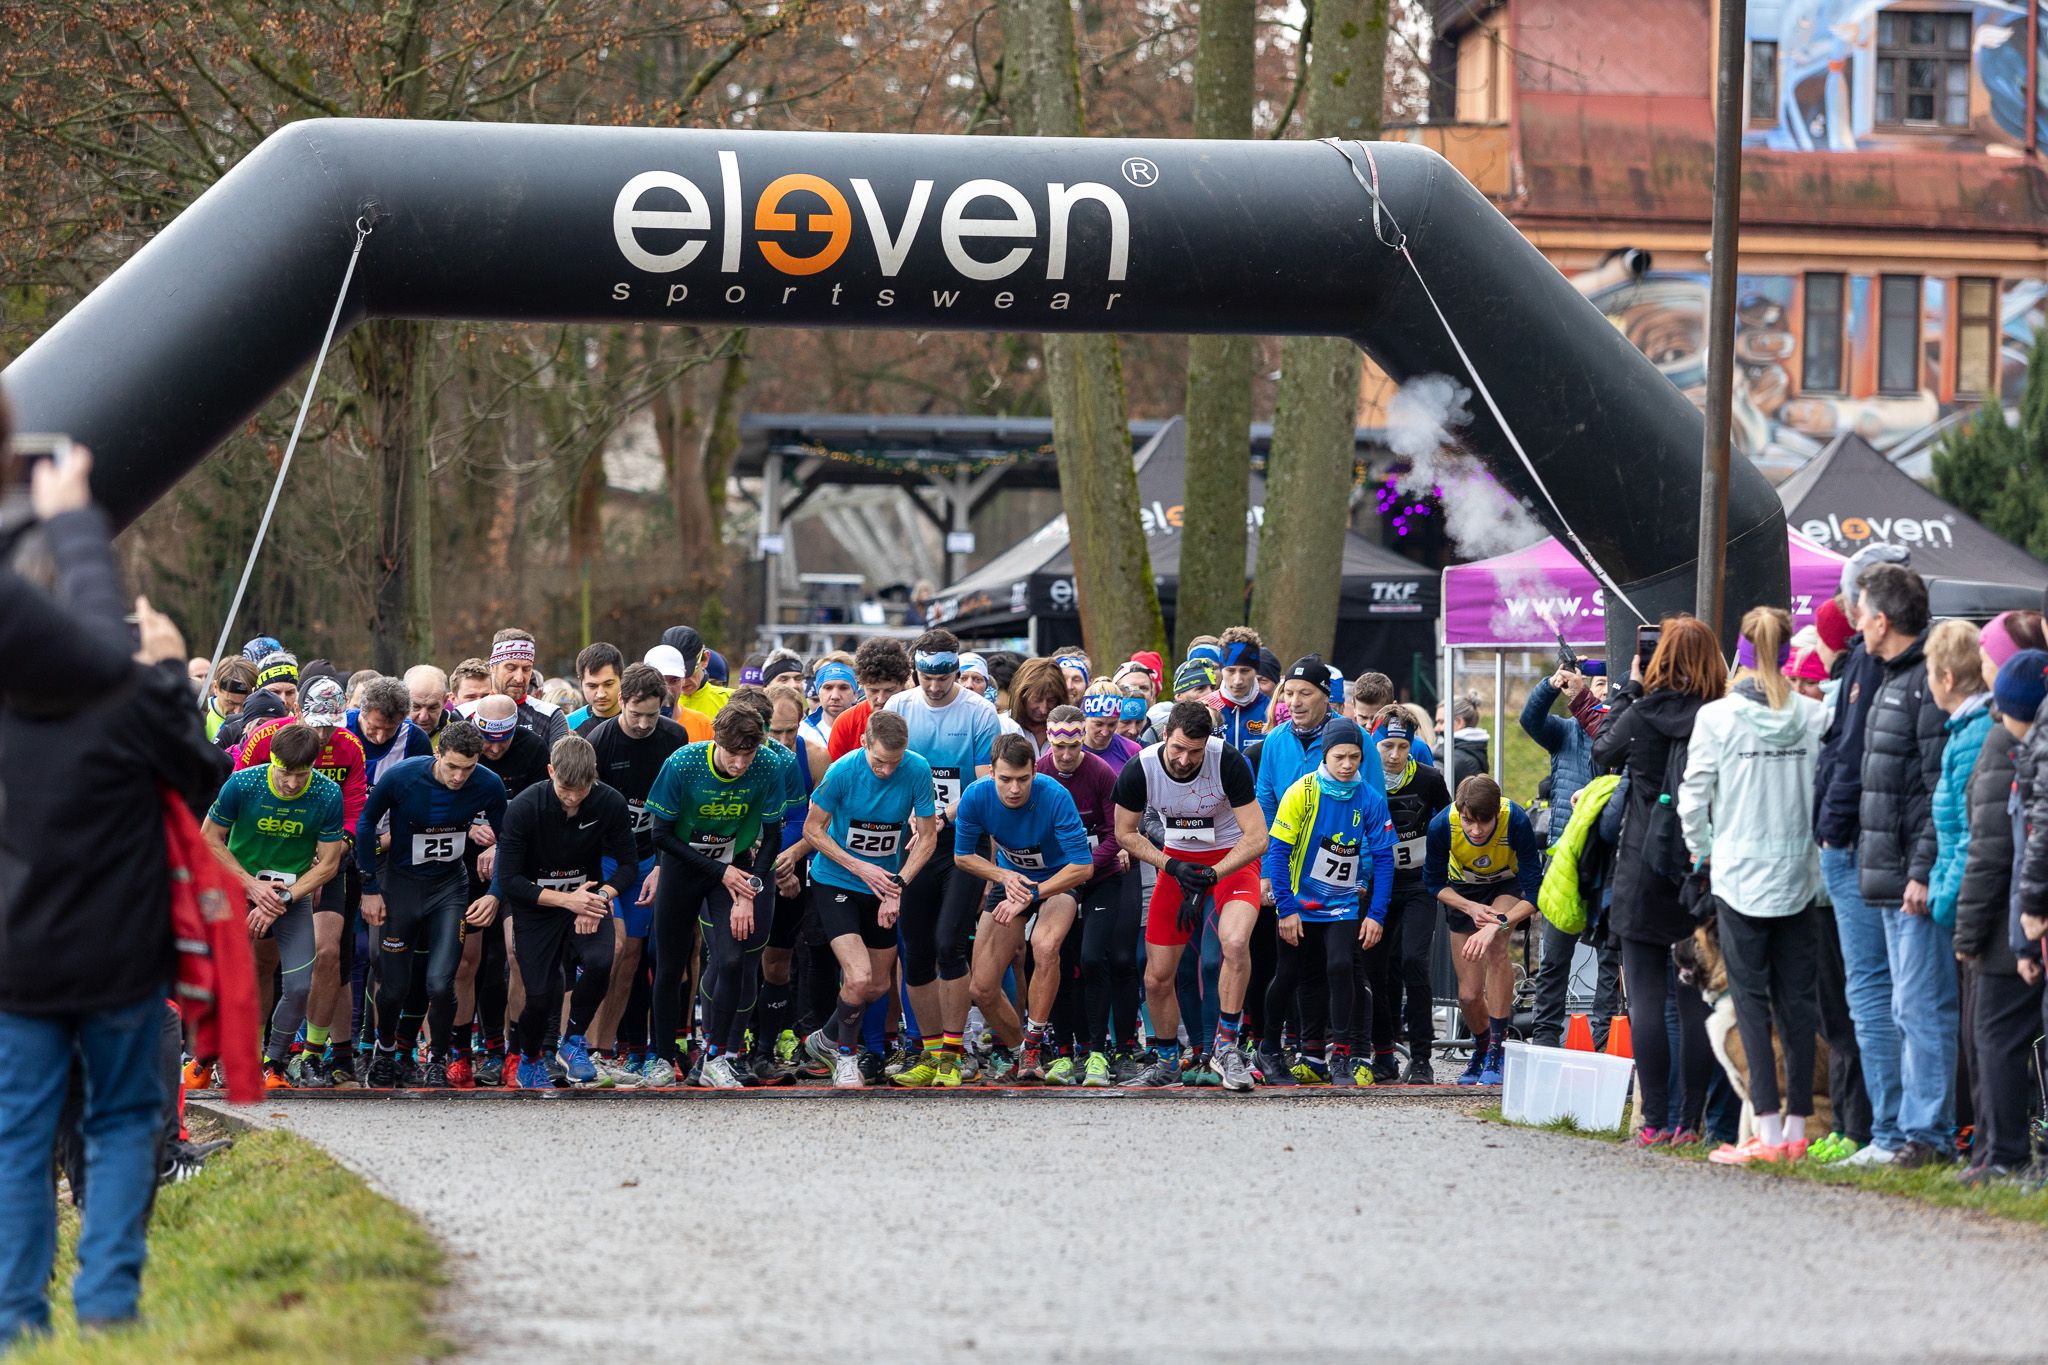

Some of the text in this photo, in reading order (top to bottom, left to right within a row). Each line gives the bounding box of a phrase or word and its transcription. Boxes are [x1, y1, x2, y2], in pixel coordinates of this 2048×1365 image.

[613, 150, 1130, 281] eleven
[611, 280, 1122, 310] sportswear
[1801, 512, 1953, 544] eleven
[1370, 582, 1419, 601] TKF
[699, 802, 749, 817] eleven
[257, 815, 304, 835] eleven
[425, 826, 457, 834] eleven
[861, 823, 893, 831] eleven
[1175, 819, 1204, 827] eleven
[423, 837, 454, 859] 25
[849, 833, 896, 852] 220
[1330, 843, 1356, 855] eleven
[550, 868, 580, 878] eleven
[1325, 858, 1352, 882] 79
